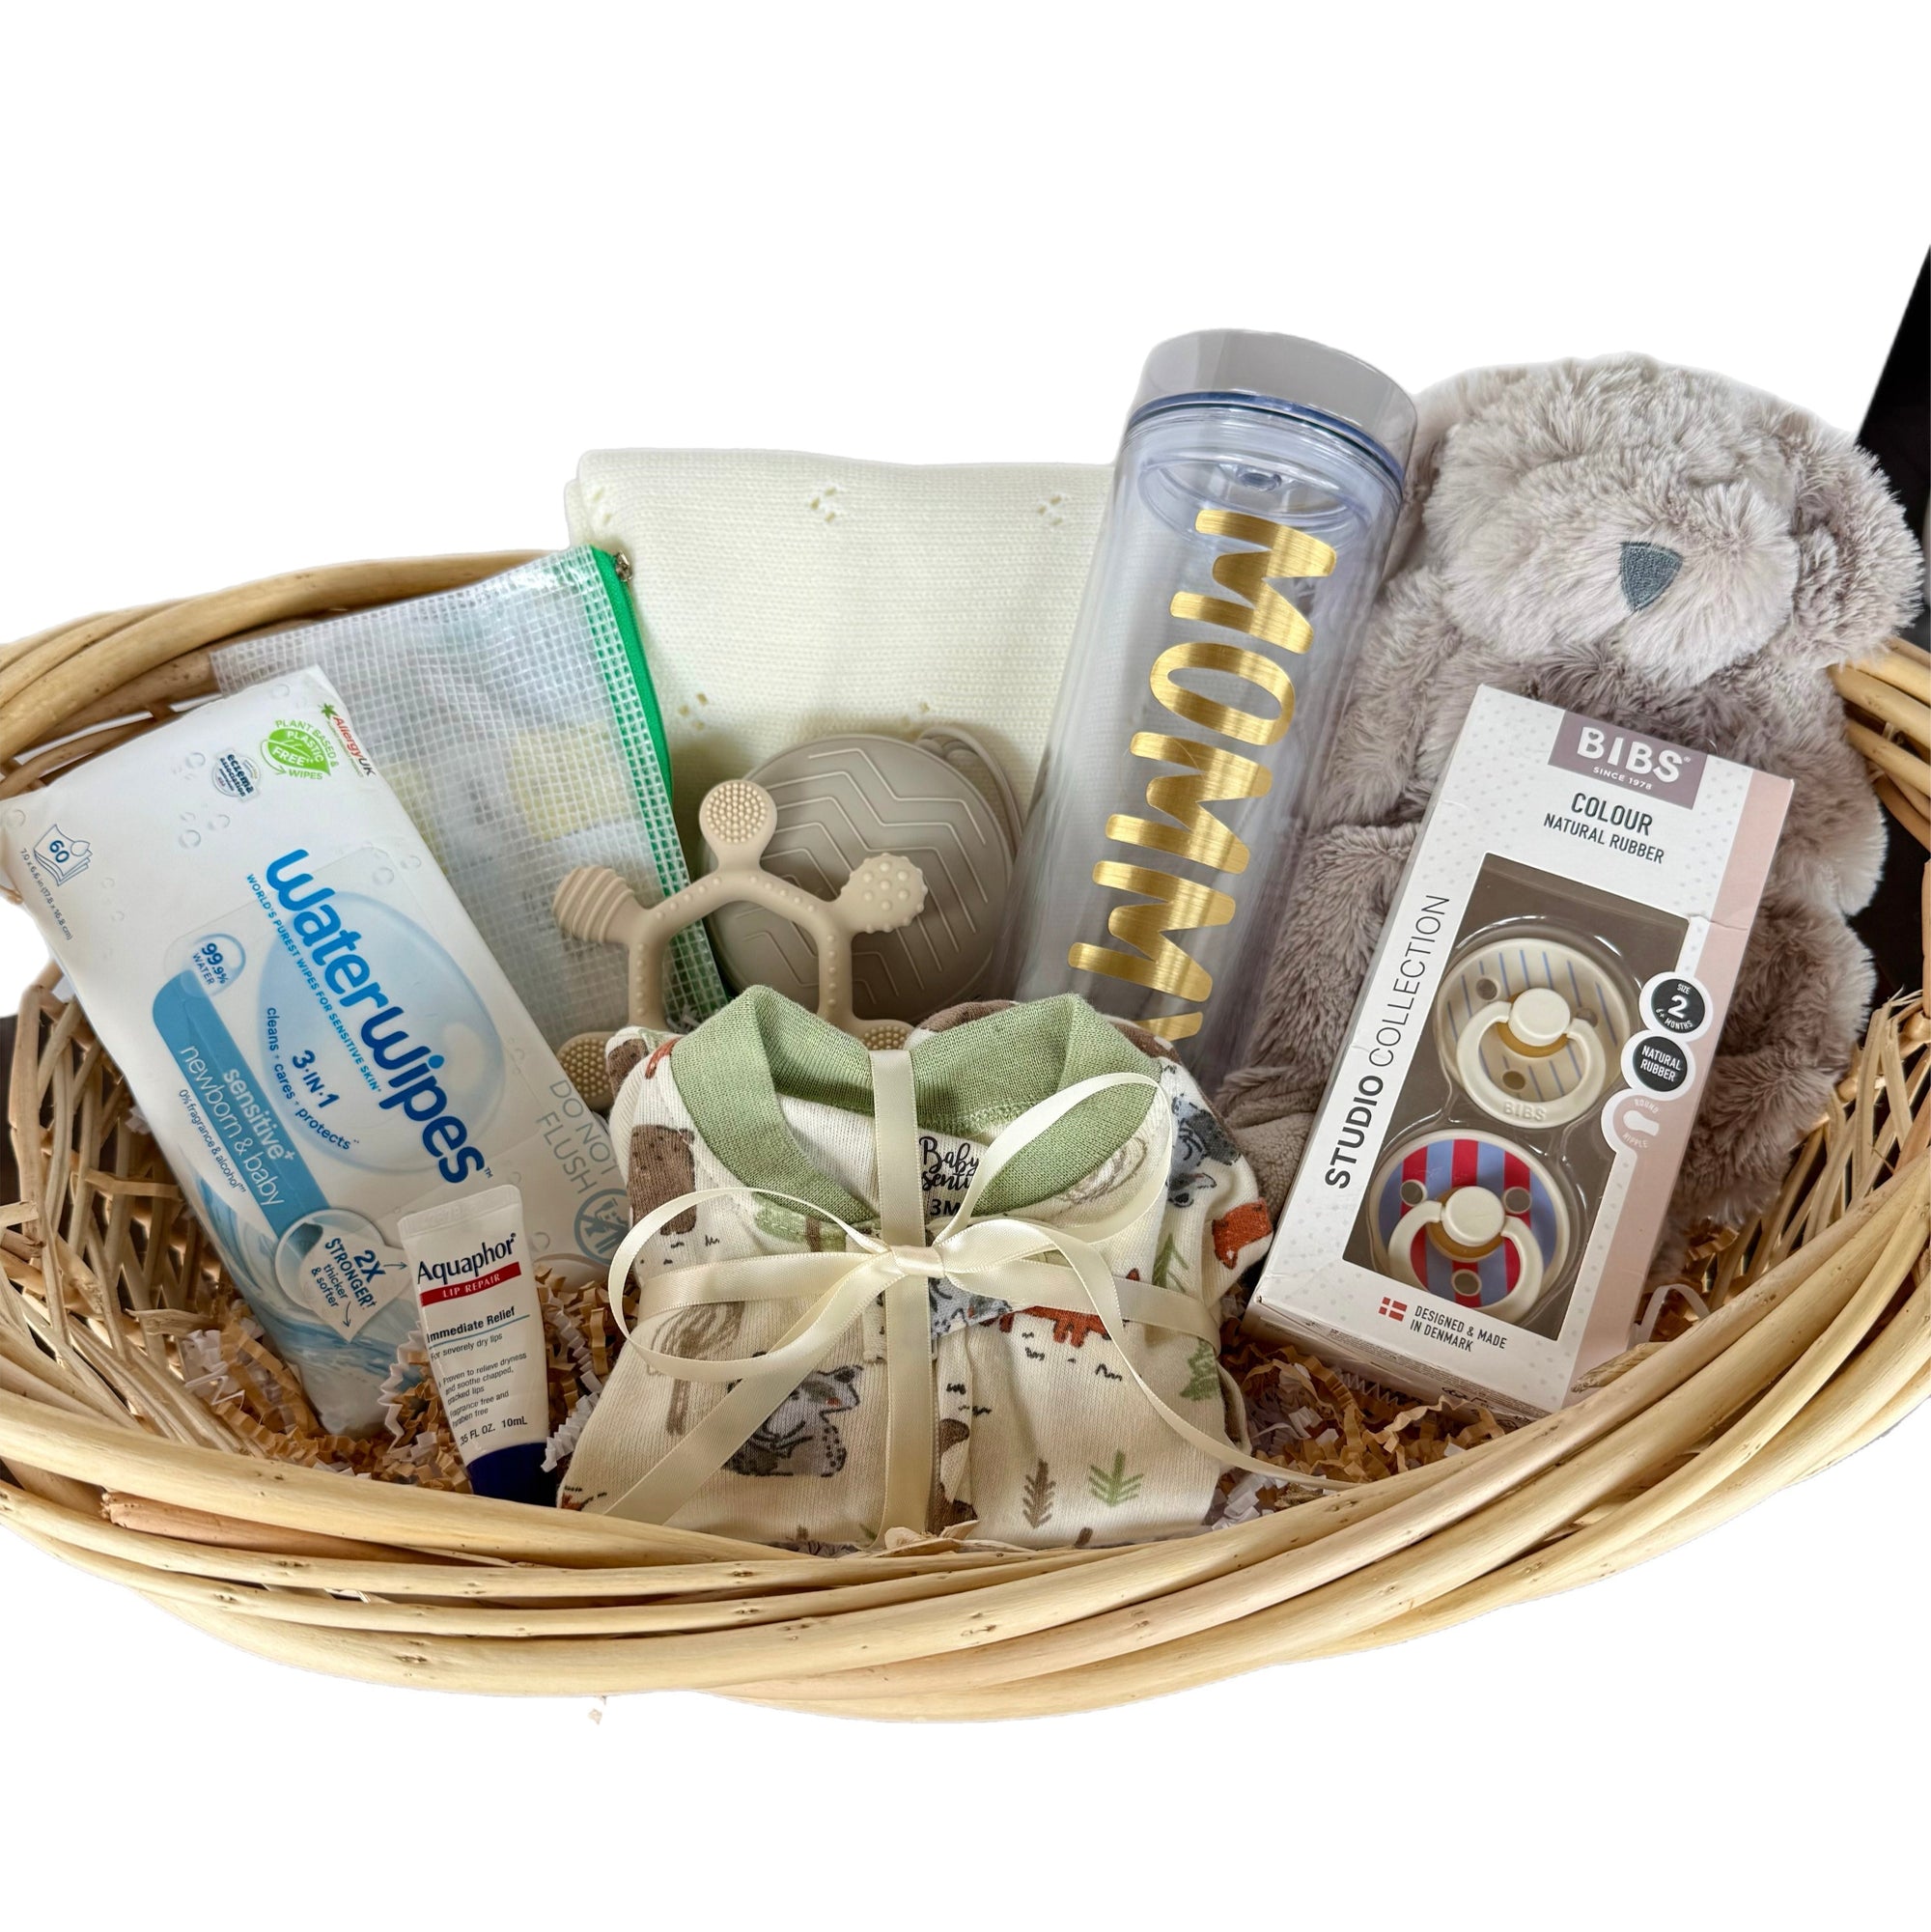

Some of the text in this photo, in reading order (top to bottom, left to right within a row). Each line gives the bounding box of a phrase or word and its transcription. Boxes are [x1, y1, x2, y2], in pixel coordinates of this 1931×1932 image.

[275, 719, 314, 731] PLANT
[312, 729, 337, 758] BASED
[287, 731, 324, 763] PLASTIC
[227, 753, 254, 794] eczema
[289, 770, 323, 780] WIPES
[1068, 509, 1336, 1042] MOMM
[1592, 766, 1653, 790] SINCE 1978
[1570, 792, 1653, 836] COLOUR
[49, 840, 70, 863] 60
[1543, 813, 1665, 864] NATURAL RUBBER
[192, 952, 215, 985] WATER
[201, 942, 229, 984] 99.9%
[246, 874, 277, 918] WORLD'S
[272, 919, 301, 957] PUREST
[296, 958, 321, 991] WIPES
[316, 991, 333, 1012] FOR
[328, 1013, 365, 1065] SENSITIVE
[1676, 983, 1691, 994] SIZE
[1664, 1017, 1693, 1030] MONTHS
[1667, 994, 1688, 1020] 2
[266, 1007, 280, 1051] cleans
[274, 1063, 295, 1100] cares
[1325, 894, 1450, 1190] STUDIO COLLECTION
[1641, 1045, 1682, 1071] NATURAL
[1640, 1058, 1676, 1082] RUBBER
[179, 1089, 192, 1105] 0%
[186, 1103, 216, 1147] fragrance
[210, 1146, 222, 1158] &
[180, 1046, 285, 1206] newborn & baby
[549, 1079, 619, 1175] DO NOT
[1503, 1101, 1547, 1122] BIBS
[537, 1110, 598, 1194] FLUSH
[918, 1135, 980, 1177] Baby
[323, 1263, 349, 1300] thicker
[353, 1249, 386, 1283] 2X
[311, 1267, 339, 1307] & softer
[442, 1274, 501, 1299] LIP REPAIR
[427, 1305, 516, 1344] Immediate Relief
[1410, 1319, 1422, 1332] IN
[1423, 1324, 1473, 1352] DENMARK
[1414, 1304, 1508, 1349] DESIGNED & MADE
[442, 1343, 475, 1356] severely
[476, 1338, 489, 1348] dry
[490, 1332, 503, 1343] lips
[442, 1372, 465, 1386] Proven
[476, 1361, 499, 1374] relieve
[499, 1353, 527, 1366] dryness
[457, 1377, 481, 1389] soothe
[472, 1386, 485, 1395] lips
[480, 1396, 494, 1405] free
[495, 1390, 510, 1400] and
[469, 1429, 480, 1440] FL
[481, 1422, 496, 1435] OZ.
[501, 1415, 528, 1428] 10mL
[474, 1408, 489, 1416] free
